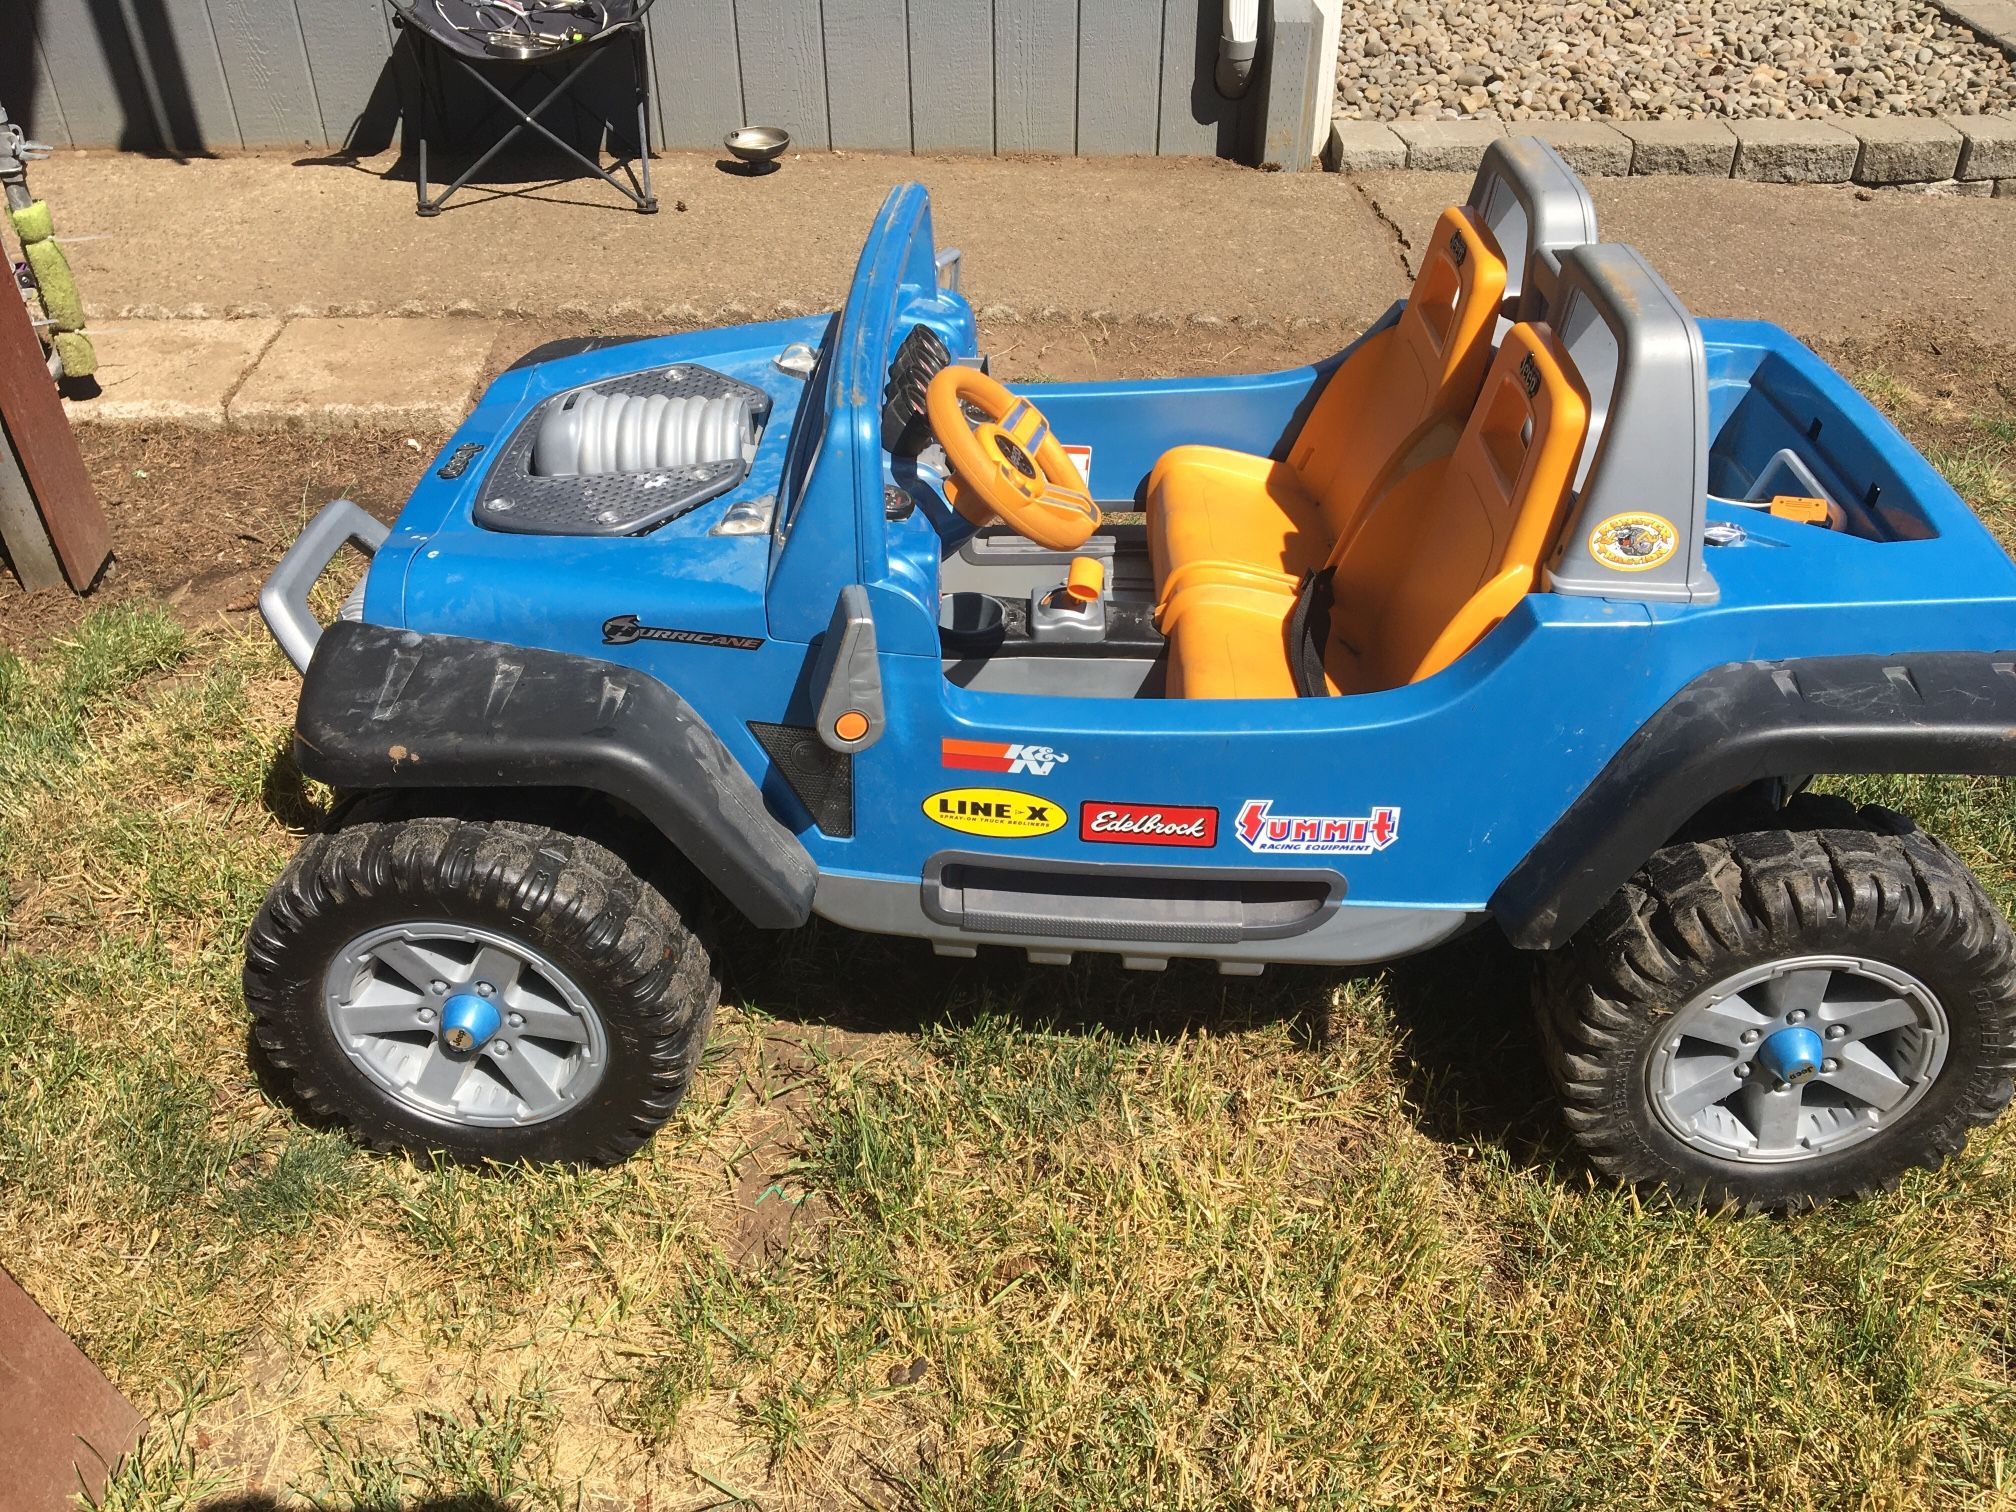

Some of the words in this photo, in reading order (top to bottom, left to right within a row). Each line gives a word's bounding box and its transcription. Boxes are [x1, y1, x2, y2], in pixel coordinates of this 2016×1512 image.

[602, 615, 766, 650] HURRICANE
[1090, 811, 1205, 838] Edelbrock
[453, 1029, 466, 1047] Jeep
[1788, 1065, 1815, 1080] Jeep
